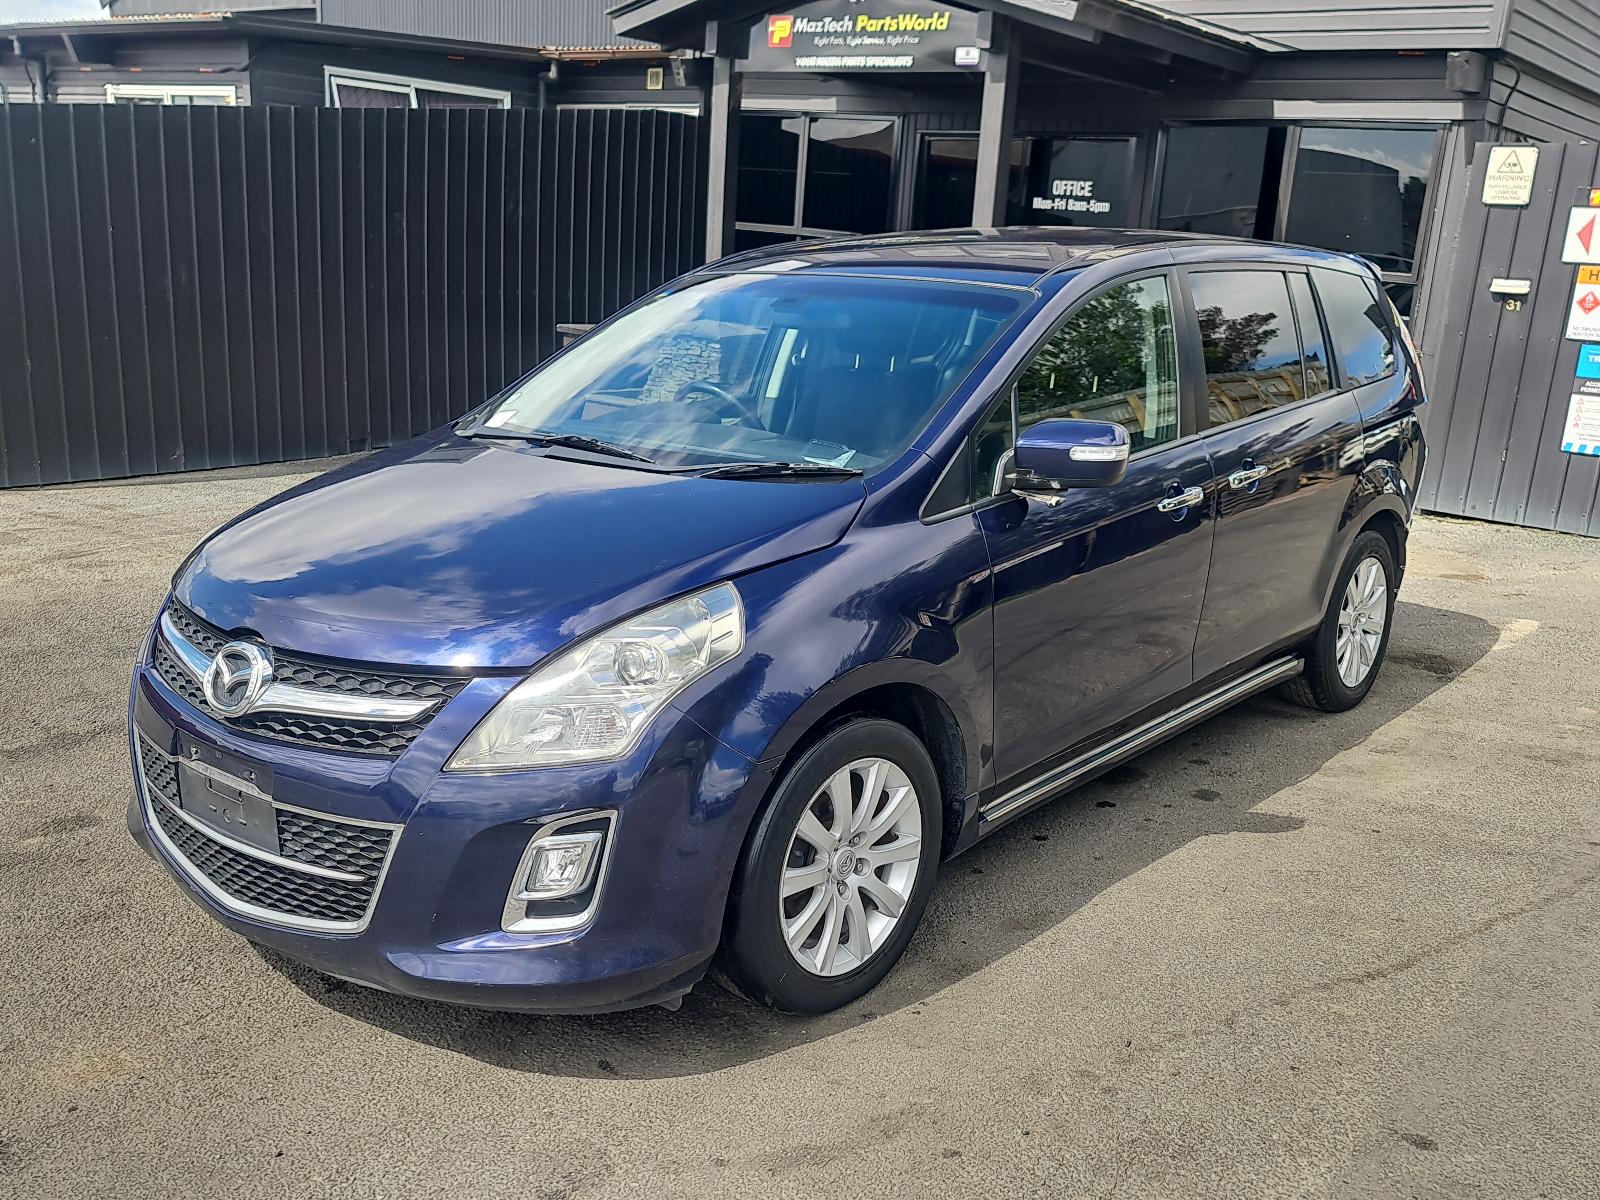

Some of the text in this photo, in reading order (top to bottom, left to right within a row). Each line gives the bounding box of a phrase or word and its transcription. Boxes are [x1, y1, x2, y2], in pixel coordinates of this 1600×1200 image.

[794, 12, 951, 33] MazTech PartsWorld
[1488, 174, 1530, 182] WARNING
[1052, 180, 1093, 196] OFFICE
[1032, 197, 1067, 210] Mon-Fri
[1505, 299, 1522, 312] 31
